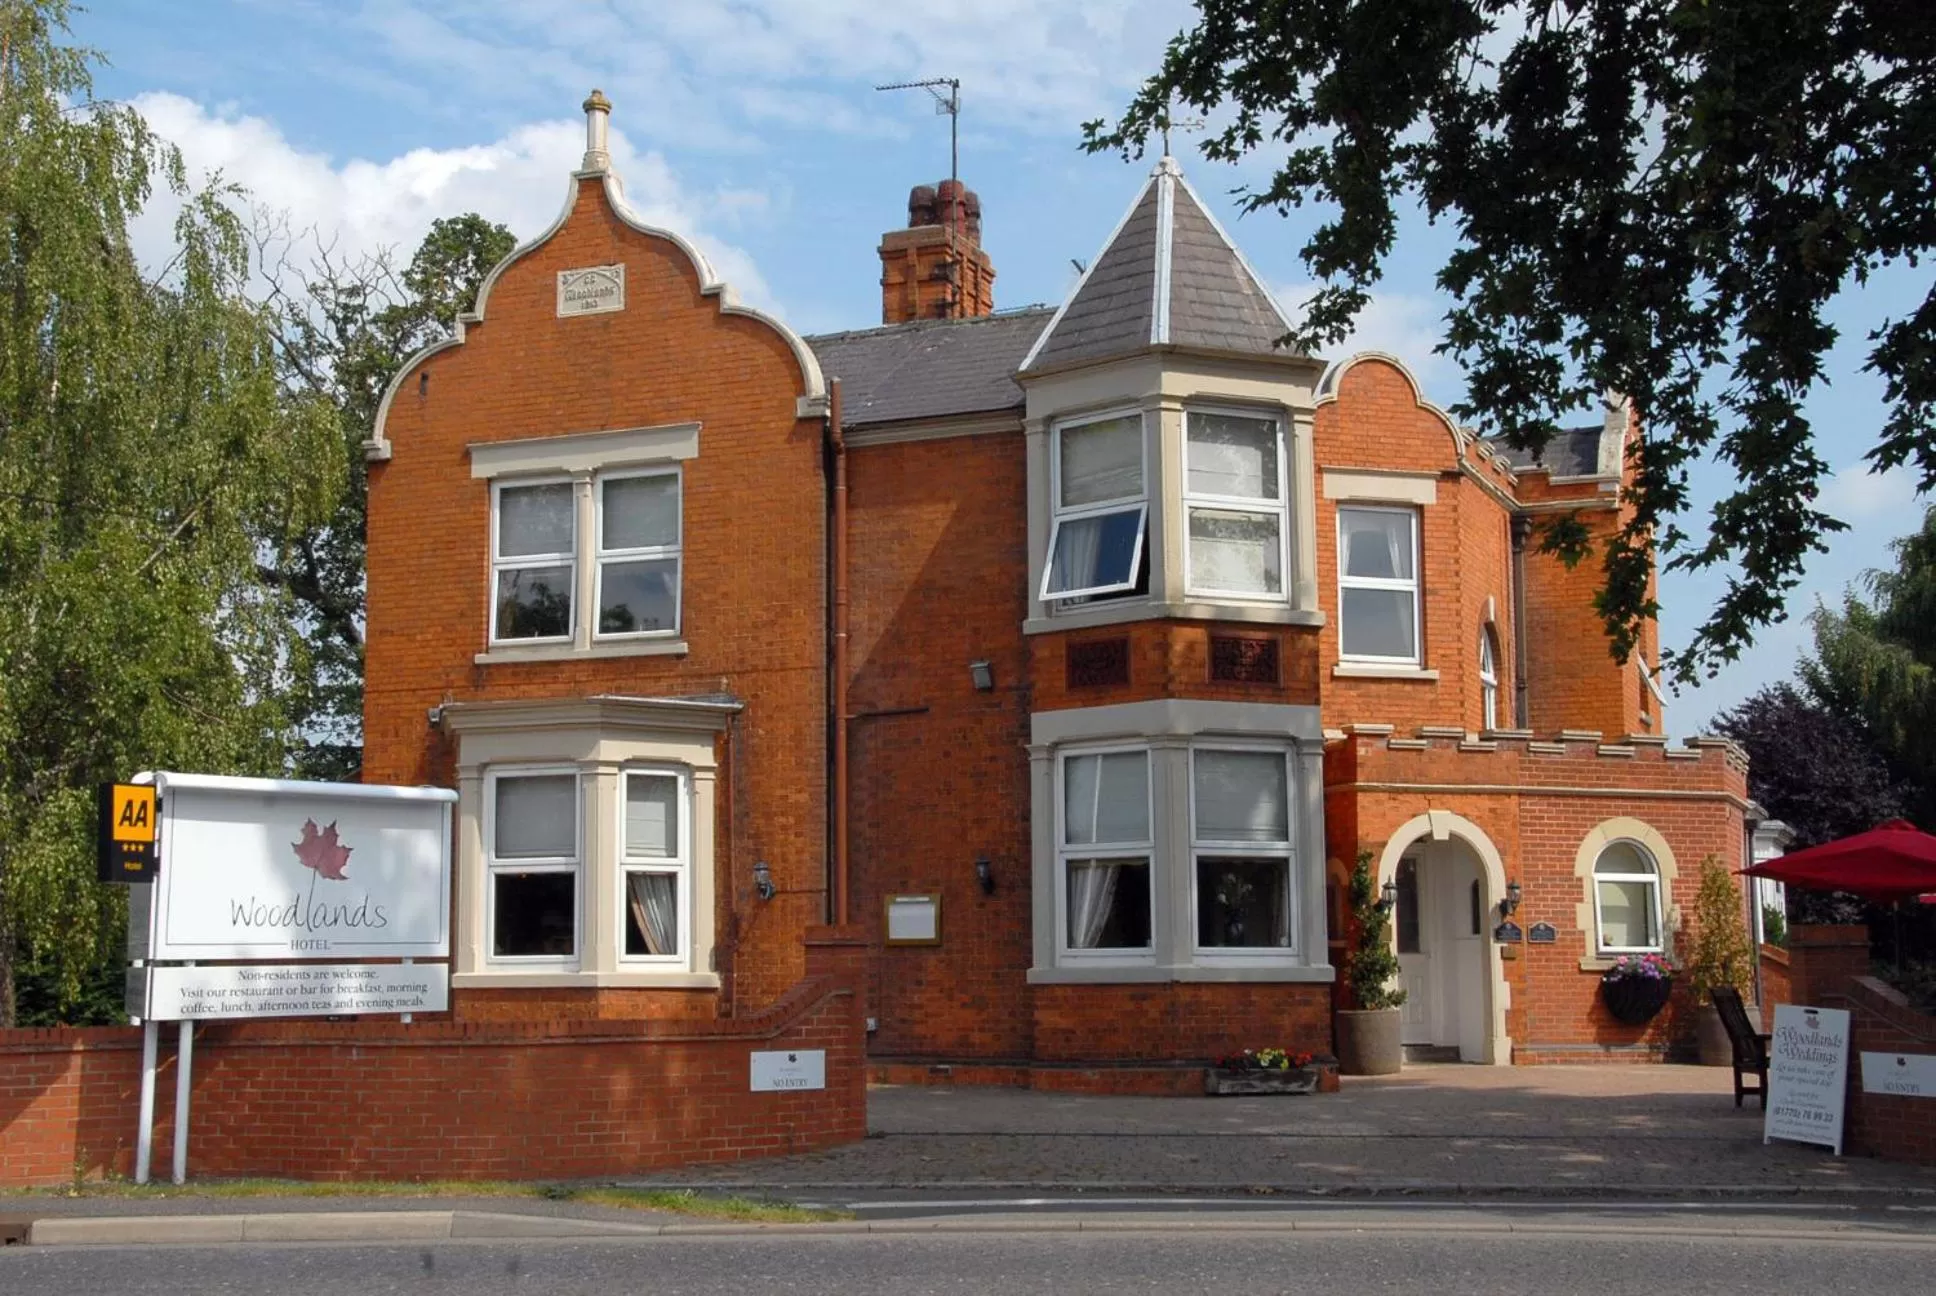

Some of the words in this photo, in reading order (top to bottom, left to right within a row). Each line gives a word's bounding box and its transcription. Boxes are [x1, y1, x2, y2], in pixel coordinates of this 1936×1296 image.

[119, 800, 148, 828] AA
[231, 882, 388, 932] Woodlands
[291, 939, 330, 951] HOTEL
[238, 969, 311, 981] Non-residents
[313, 971, 330, 979] are
[180, 987, 204, 998] Visit
[207, 988, 226, 997] our
[229, 986, 283, 997] restaurant
[285, 986, 299, 995] or
[301, 984, 318, 995] bar
[320, 983, 334, 994] for
[386, 981, 428, 994] morning
[221, 1001, 255, 1013] lunch,
[257, 999, 310, 1012] afternoon
[311, 1000, 332, 1010] teas
[335, 998, 354, 1009] and
[355, 998, 394, 1010] evening
[1776, 1026, 1842, 1048] Woodlands
[1778, 1042, 1838, 1067] Weddings
[773, 1079, 784, 1087] NO
[785, 1079, 808, 1087] ENTRY
